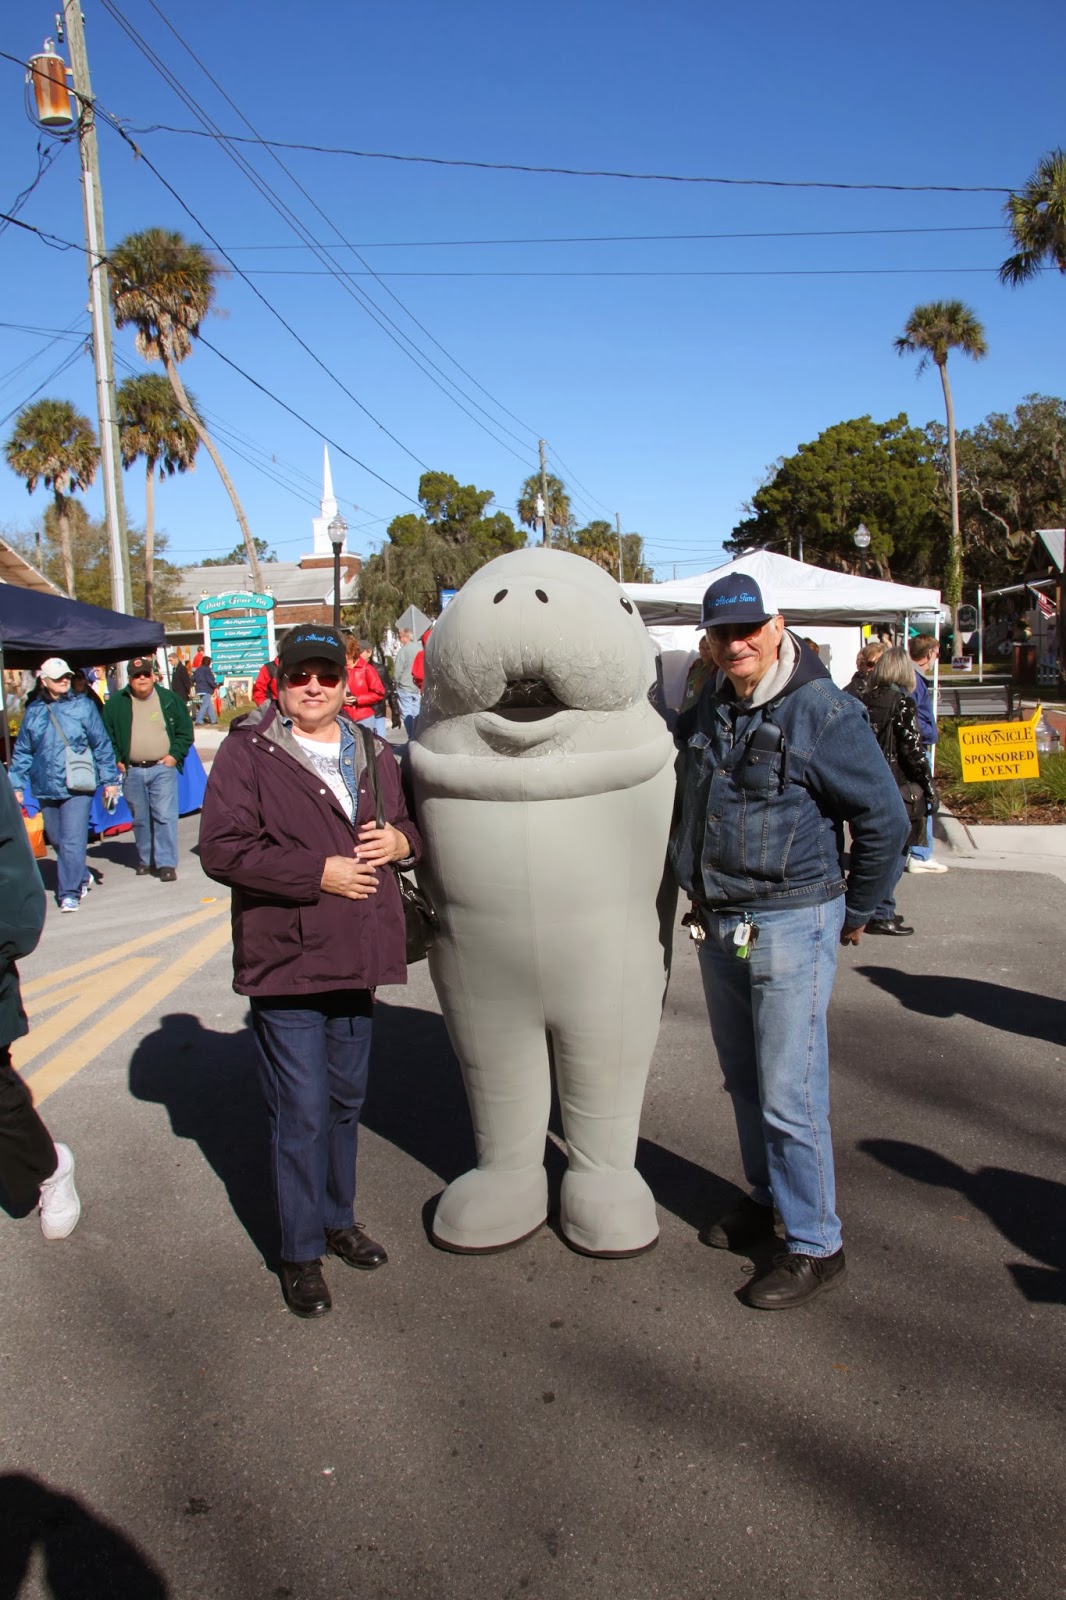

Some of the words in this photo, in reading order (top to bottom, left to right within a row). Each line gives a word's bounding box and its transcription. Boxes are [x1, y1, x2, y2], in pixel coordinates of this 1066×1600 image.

[962, 727, 1033, 747] CHRONICLE
[964, 750, 1035, 765] SPONSORED
[981, 764, 1021, 776] EVENT
